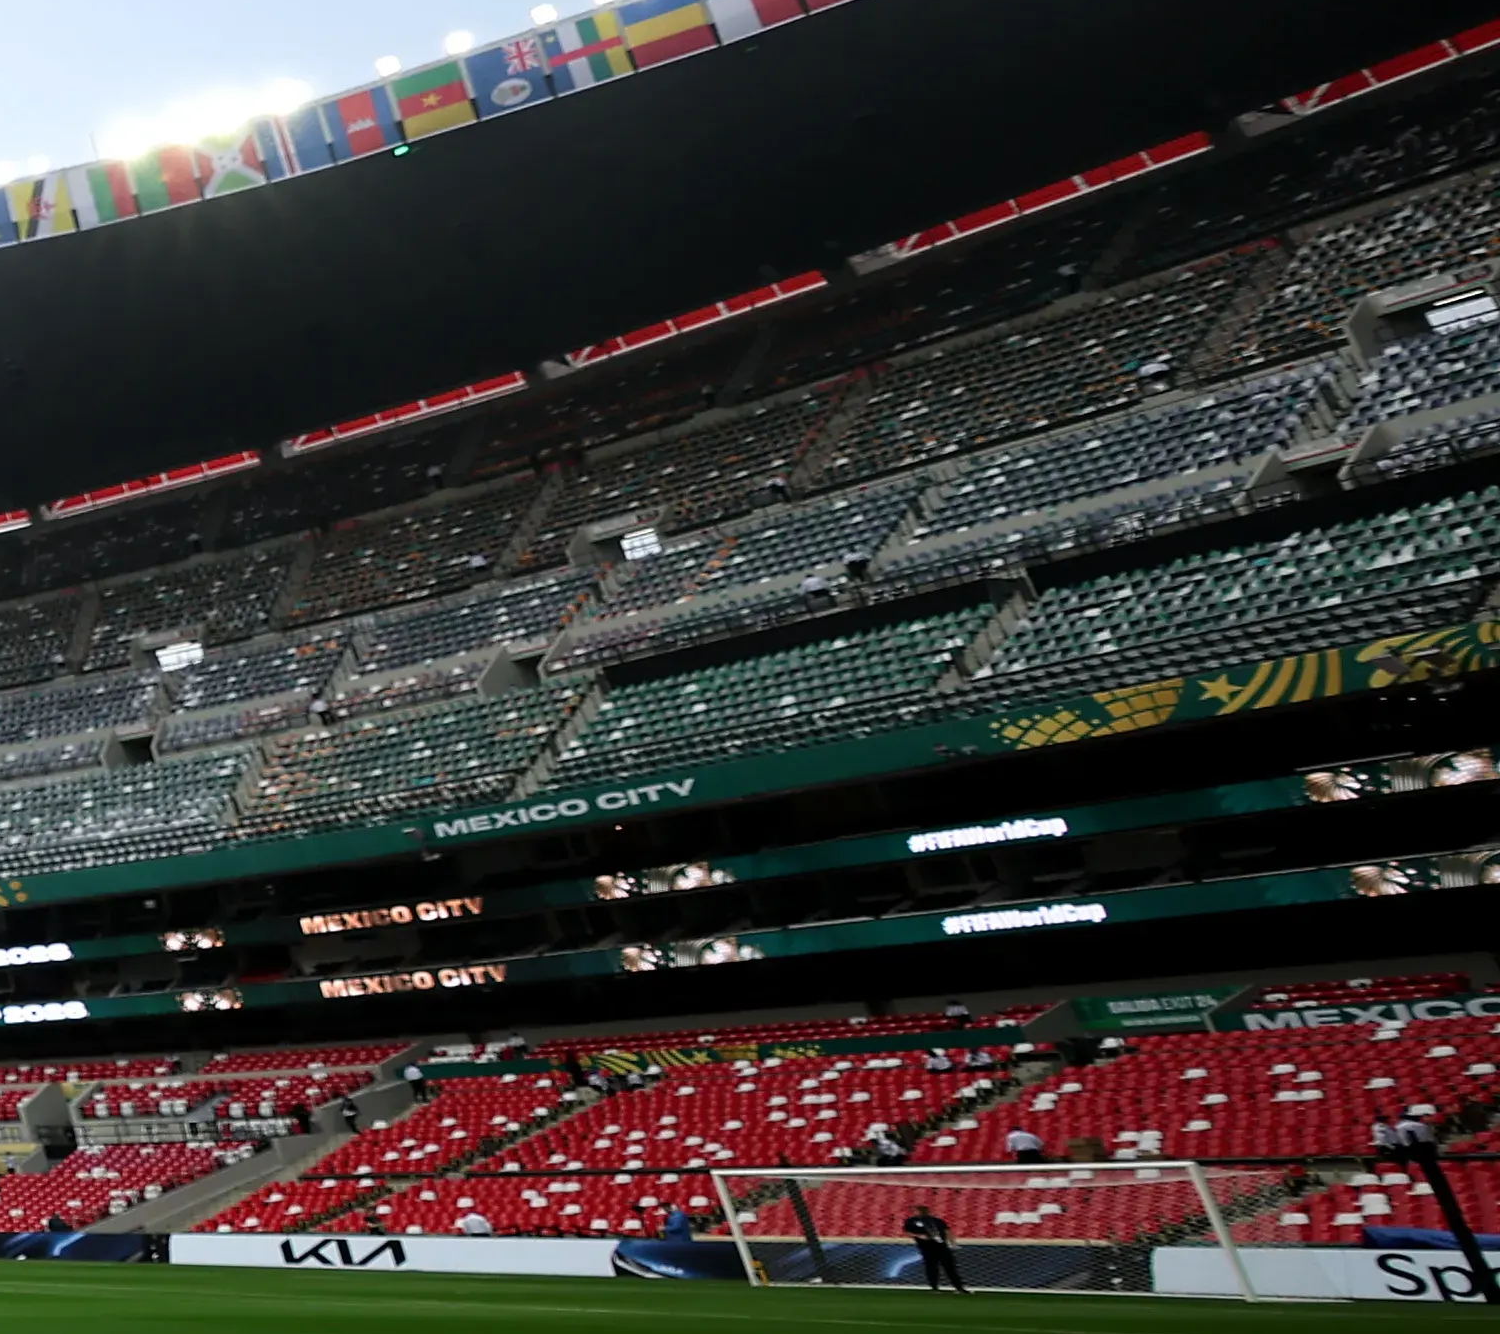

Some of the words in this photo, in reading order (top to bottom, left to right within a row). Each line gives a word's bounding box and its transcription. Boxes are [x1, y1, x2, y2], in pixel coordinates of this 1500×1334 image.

[434, 797, 589, 839] MEXICO
[595, 778, 696, 812] CITY
[299, 905, 412, 936] MEXICO
[415, 896, 484, 922] CITY
[319, 969, 434, 999] MEXICO
[437, 962, 508, 990] CITY
[281, 1239, 406, 1266] KIA
[1377, 1254, 1500, 1302] Sp
